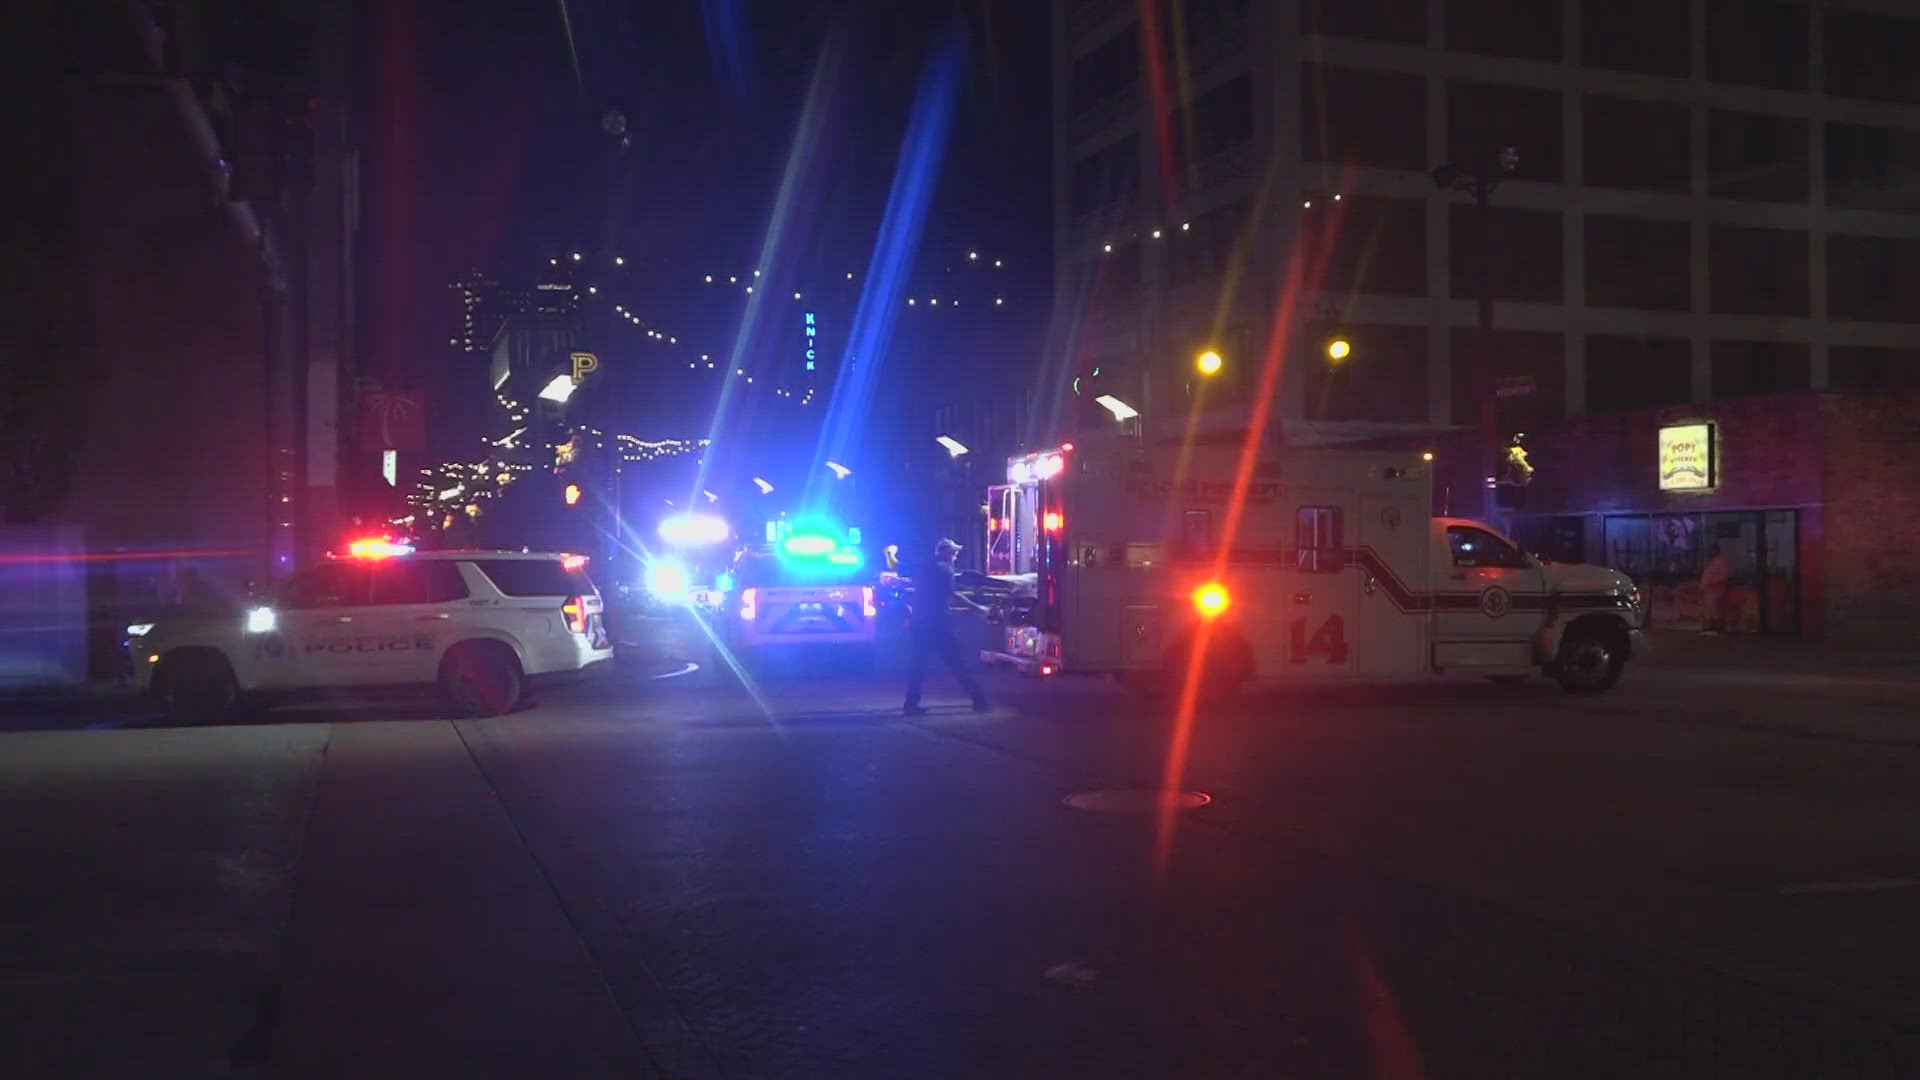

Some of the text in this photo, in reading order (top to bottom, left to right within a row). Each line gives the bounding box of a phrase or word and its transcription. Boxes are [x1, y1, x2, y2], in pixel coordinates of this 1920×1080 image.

[805, 313, 815, 370] KNICK
[571, 353, 598, 383] P
[304, 640, 435, 653] POLICE
[1289, 612, 1349, 665] 14
